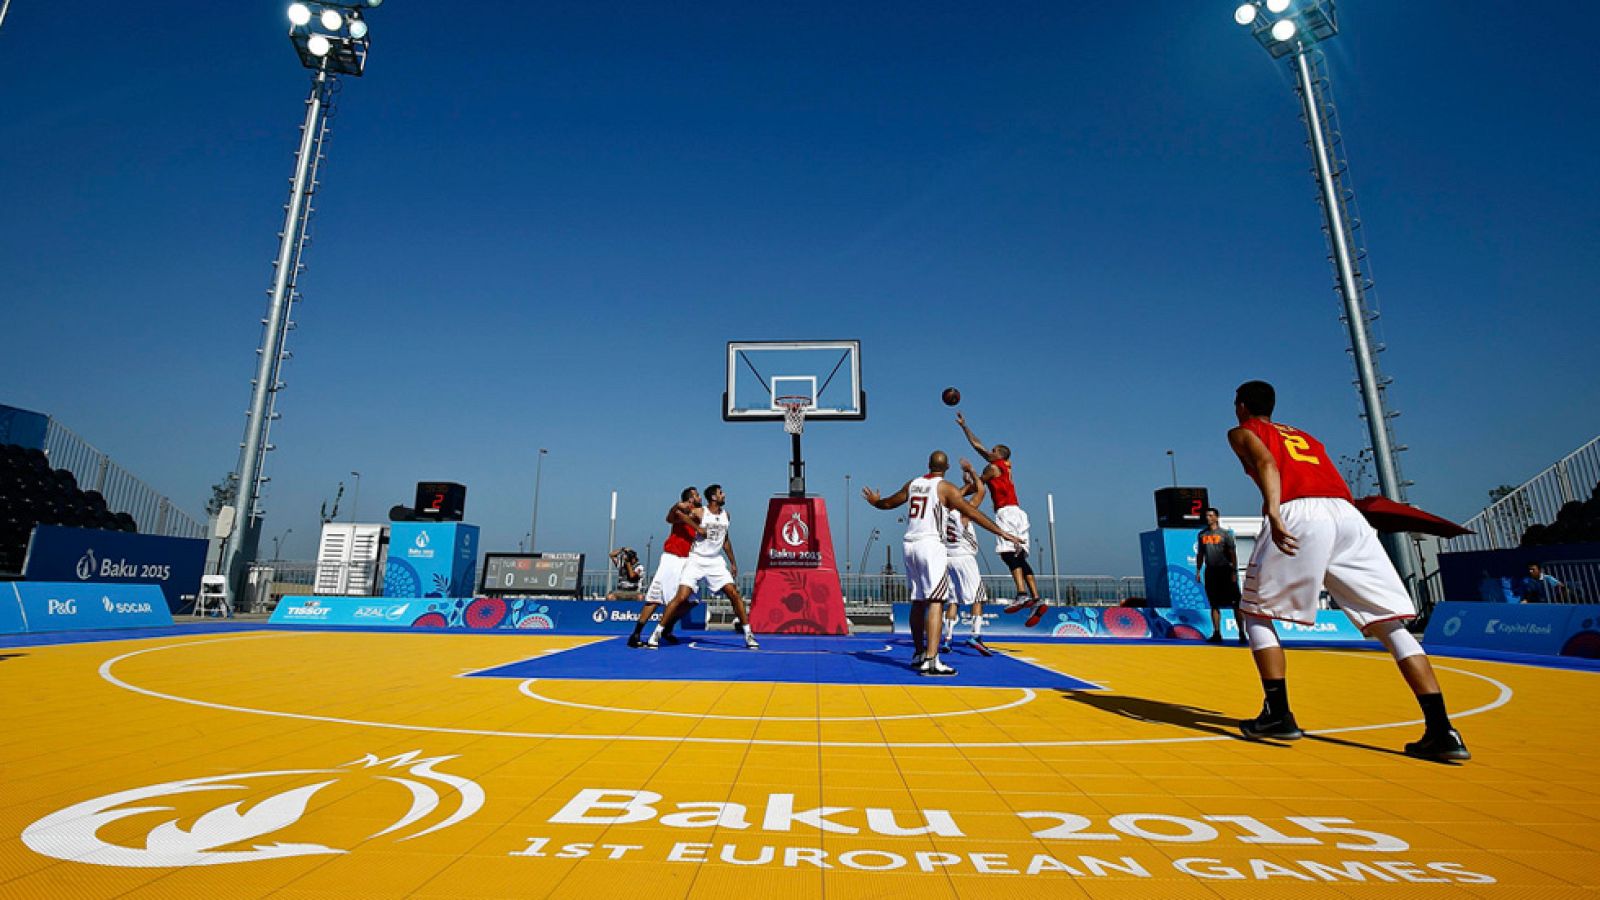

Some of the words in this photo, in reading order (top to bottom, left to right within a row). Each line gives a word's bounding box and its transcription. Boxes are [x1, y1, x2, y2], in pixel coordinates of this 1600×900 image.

[1280, 434, 1319, 464] 2
[432, 494, 445, 509] 2
[1191, 499, 1202, 516] 2
[100, 558, 138, 577] Baku
[140, 564, 171, 580] 2015
[505, 572, 514, 587] 0
[548, 573, 557, 587] 0
[48, 599, 77, 615] P&G
[115, 602, 152, 613] SOCAR
[287, 607, 332, 615] TISSOT
[354, 608, 384, 616] AZAL
[548, 788, 967, 837] Baku
[1015, 811, 1410, 852] 2015
[509, 837, 644, 860] 1ST
[666, 842, 1152, 878] EUROPEAN
[1171, 858, 1497, 884] GAMES
